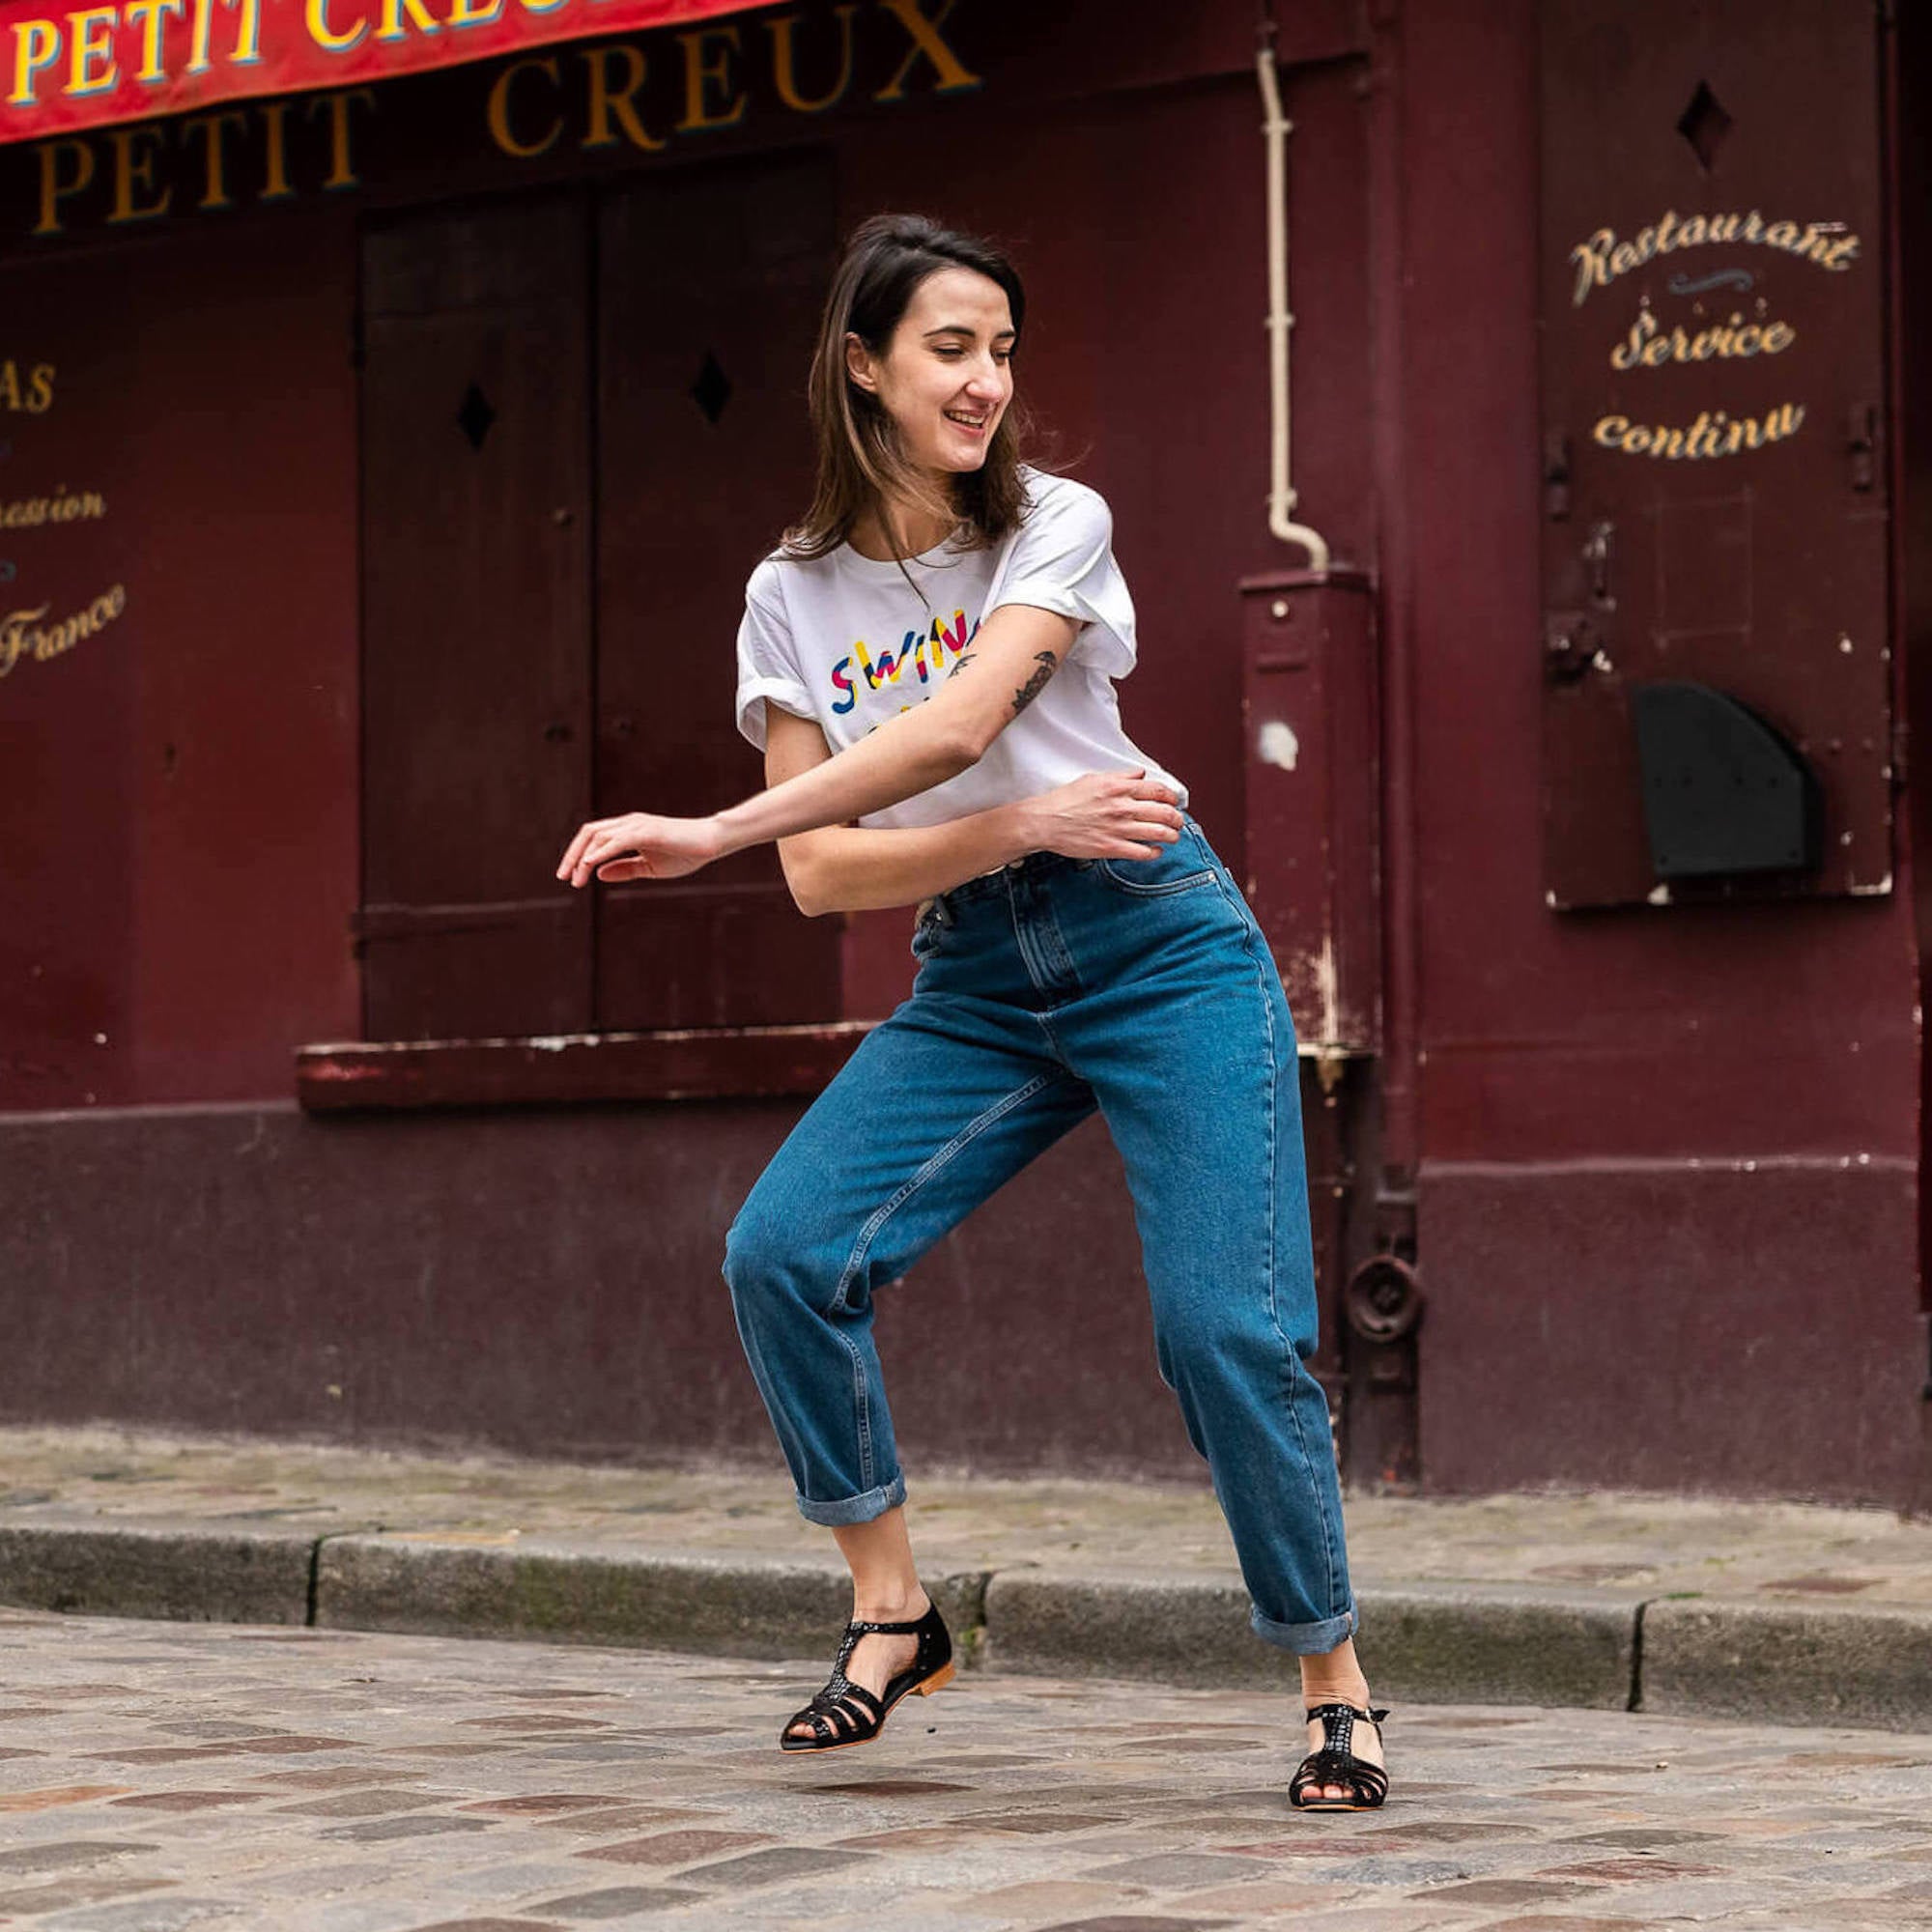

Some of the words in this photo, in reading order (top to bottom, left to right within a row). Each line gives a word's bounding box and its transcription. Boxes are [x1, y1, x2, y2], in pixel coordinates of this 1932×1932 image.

[6, 0, 279, 107] PETIT
[30, 89, 377, 236] PETIT
[487, 0, 981, 157] CREUX
[1569, 210, 1861, 308] Restaurant
[1610, 308, 1796, 370] Service
[0, 582, 127, 676] France
